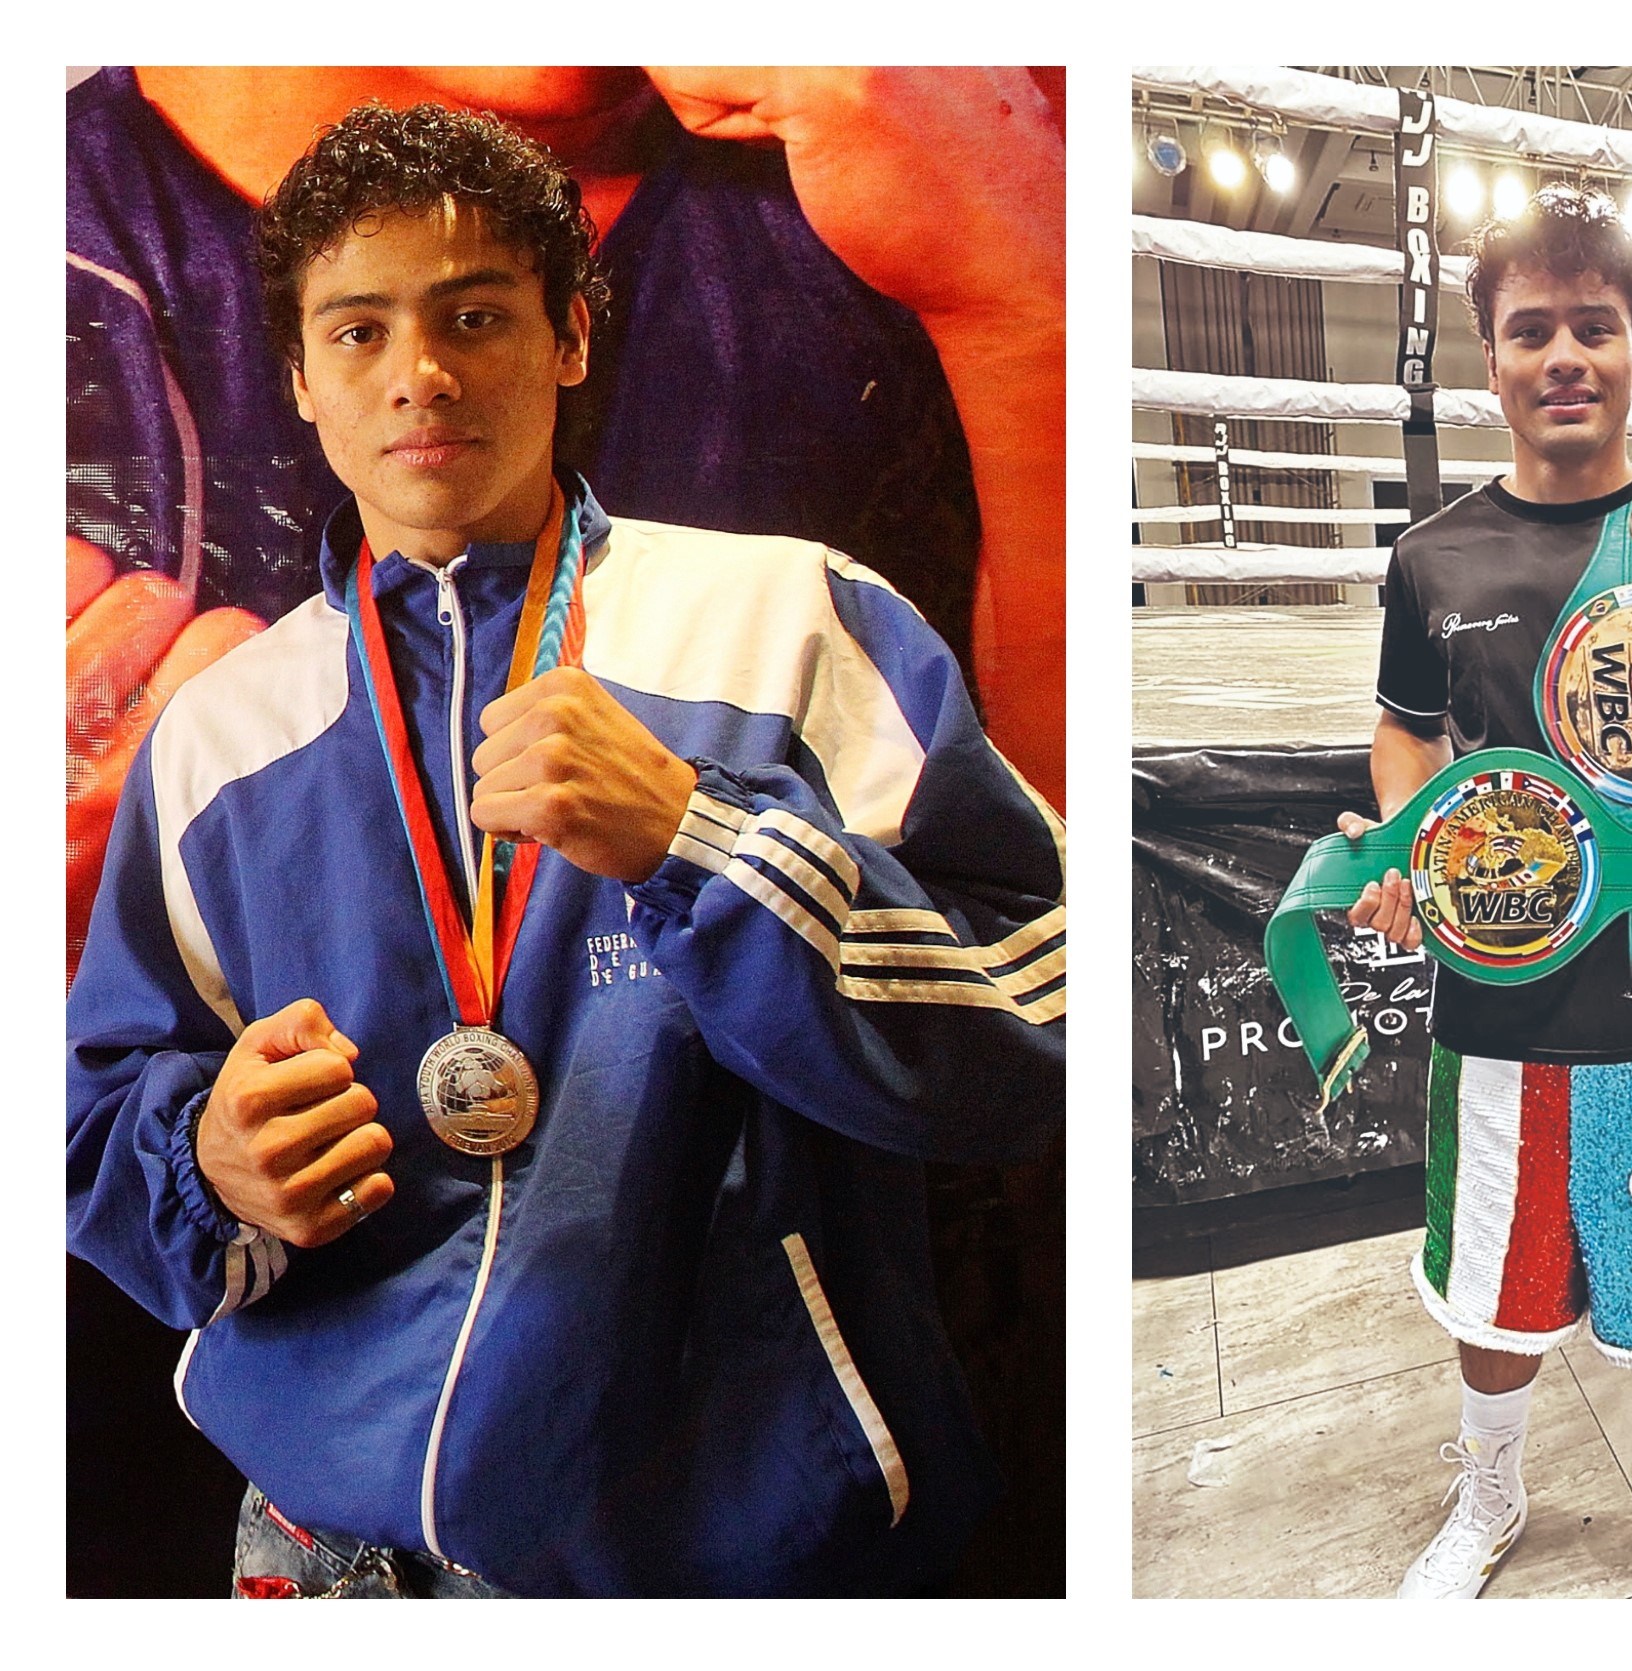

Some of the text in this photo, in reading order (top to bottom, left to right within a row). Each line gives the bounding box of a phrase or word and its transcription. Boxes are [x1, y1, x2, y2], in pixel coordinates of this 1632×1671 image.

[1401, 87, 1434, 385] JJ BOXING
[1591, 642, 1632, 756] WBC
[1433, 836, 1452, 889] LATIN
[1448, 791, 1535, 839] AMERICAN
[1461, 890, 1553, 924] WBC
[419, 1058, 438, 1091] YOUTH
[433, 1035, 462, 1058] WORLD
[463, 1032, 499, 1047] BOXING
